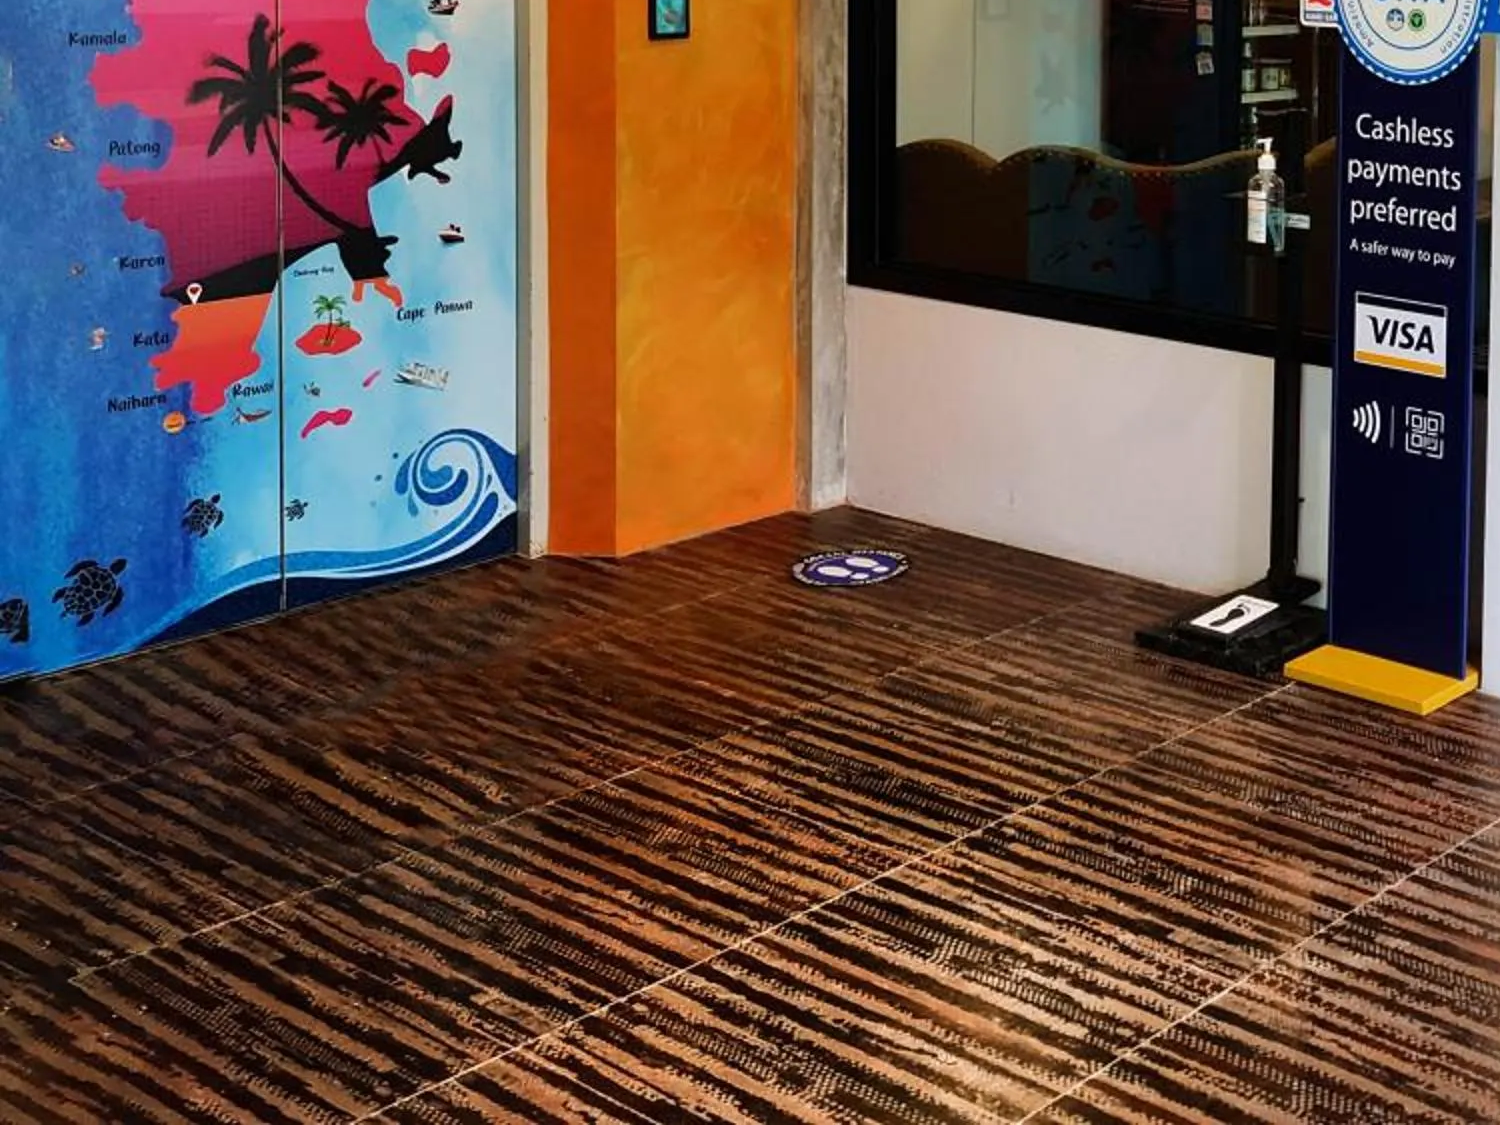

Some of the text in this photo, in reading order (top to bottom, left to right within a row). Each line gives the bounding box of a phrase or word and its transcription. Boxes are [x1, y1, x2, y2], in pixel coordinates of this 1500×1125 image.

[68, 31, 127, 47] Kamala
[1355, 113, 1454, 148] Cashless
[109, 140, 161, 158] Patong
[1347, 158, 1461, 191] payments
[1350, 197, 1456, 232] preferred
[119, 255, 165, 272] Karon
[1350, 238, 1456, 269] A safer way to pay
[397, 307, 425, 323] Cape
[132, 331, 170, 347] Kata
[1367, 315, 1434, 354] VISA
